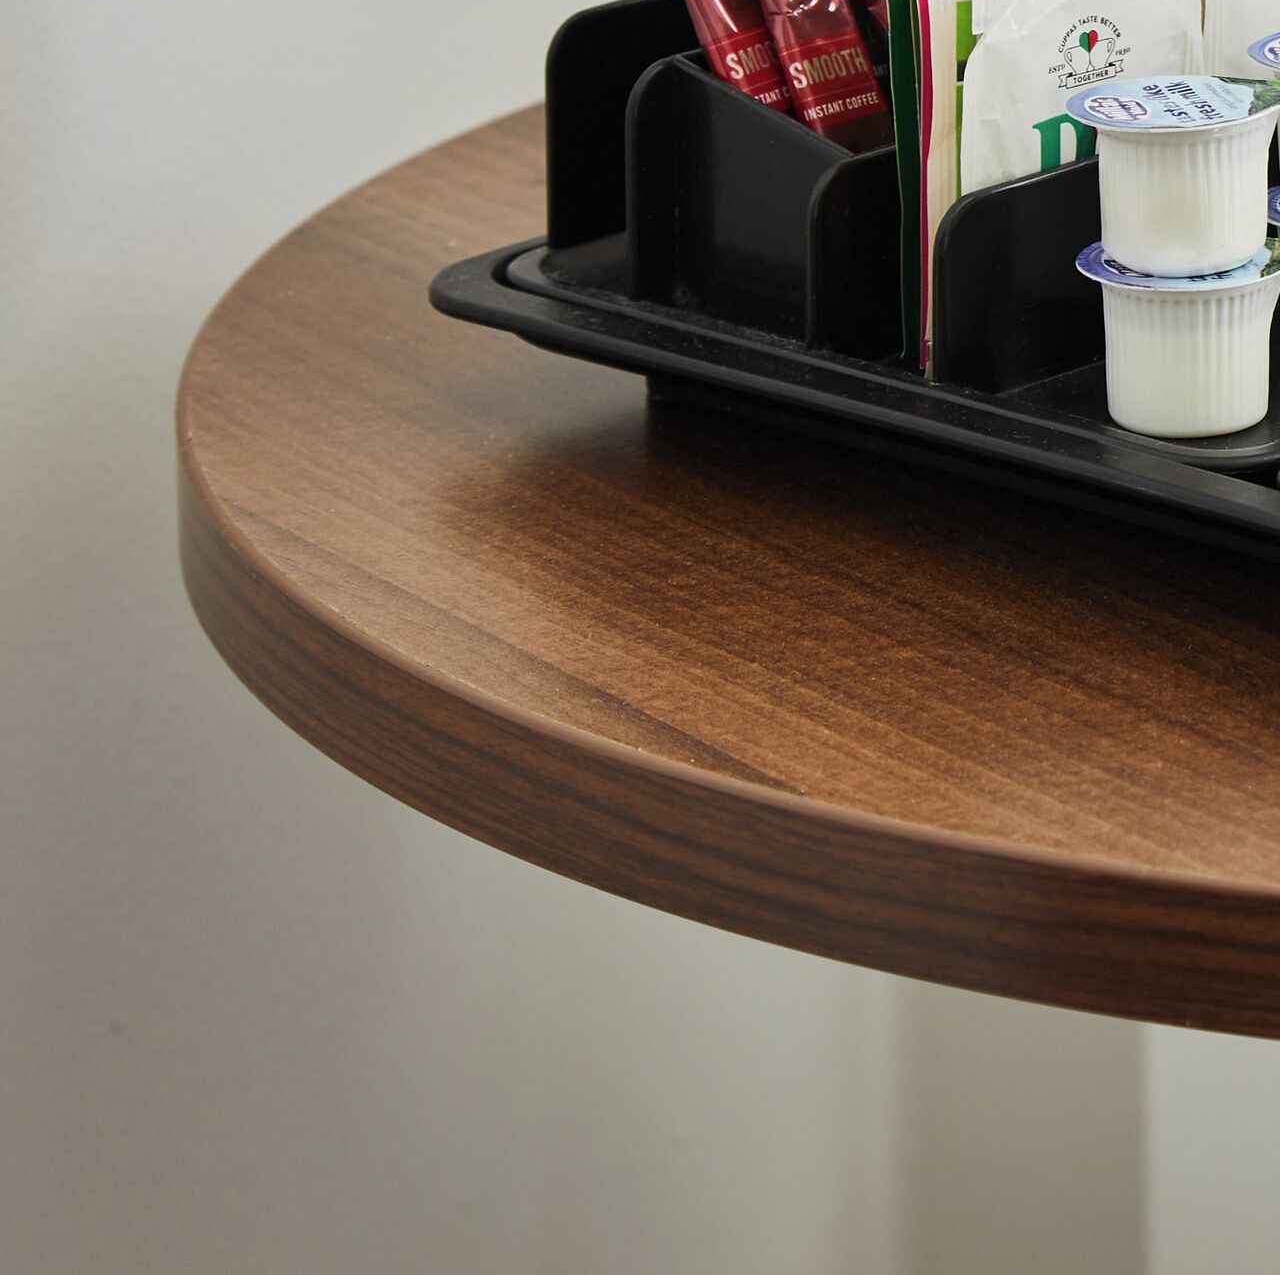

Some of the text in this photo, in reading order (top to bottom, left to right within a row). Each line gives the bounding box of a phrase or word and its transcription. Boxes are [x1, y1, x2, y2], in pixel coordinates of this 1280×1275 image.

[1058, 15, 1122, 53] CUPPAS TASTE BETTER
[789, 47, 868, 89] SMOOTH
[1073, 69, 1109, 85] TOGETHER
[1141, 85, 1197, 123] tastes like
[1165, 80, 1200, 99] milk
[804, 91, 879, 122] INSTANT COFFEE
[1184, 99, 1224, 120] fresh
